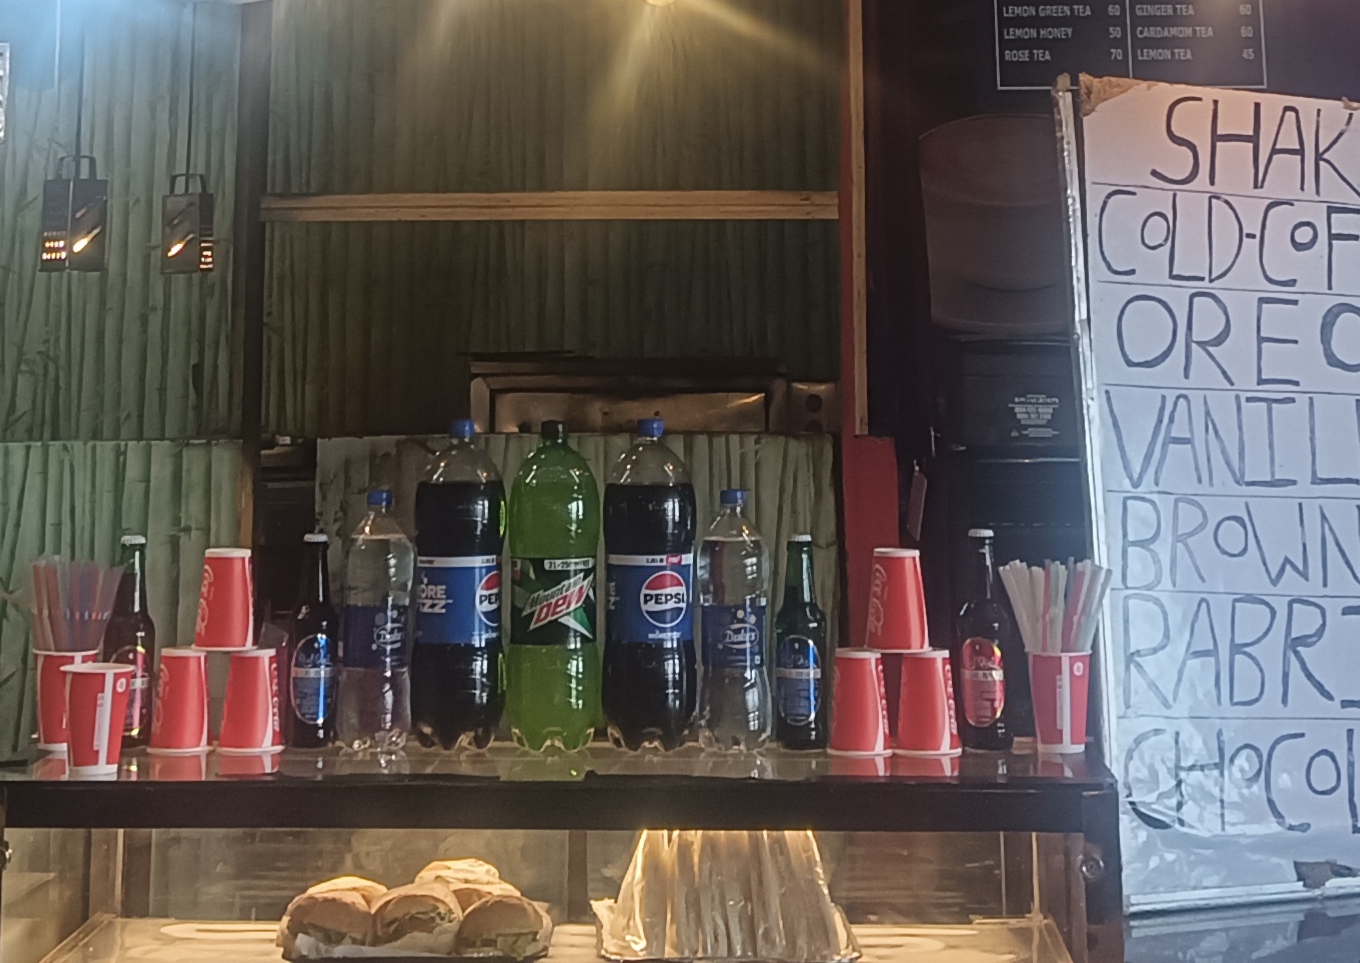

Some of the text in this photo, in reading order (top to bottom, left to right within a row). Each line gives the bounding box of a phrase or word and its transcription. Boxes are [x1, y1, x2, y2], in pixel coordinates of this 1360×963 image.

[1003, 6, 1036, 17] LEMON
[1038, 5, 1070, 17] GREEN
[1072, 5, 1091, 16] TEA
[1135, 4, 1174, 16] GINGER
[1175, 5, 1195, 16] TEA
[1004, 26, 1122, 39] LEMON HONEY 50
[1136, 27, 1193, 38] CARDAMOM
[1194, 27, 1214, 38] TEA
[1005, 49, 1122, 61] ROSE TEA 70
[1137, 49, 1172, 60] LEMON
[1173, 49, 1193, 60] TEA
[643, 592, 686, 606] PEPSI
